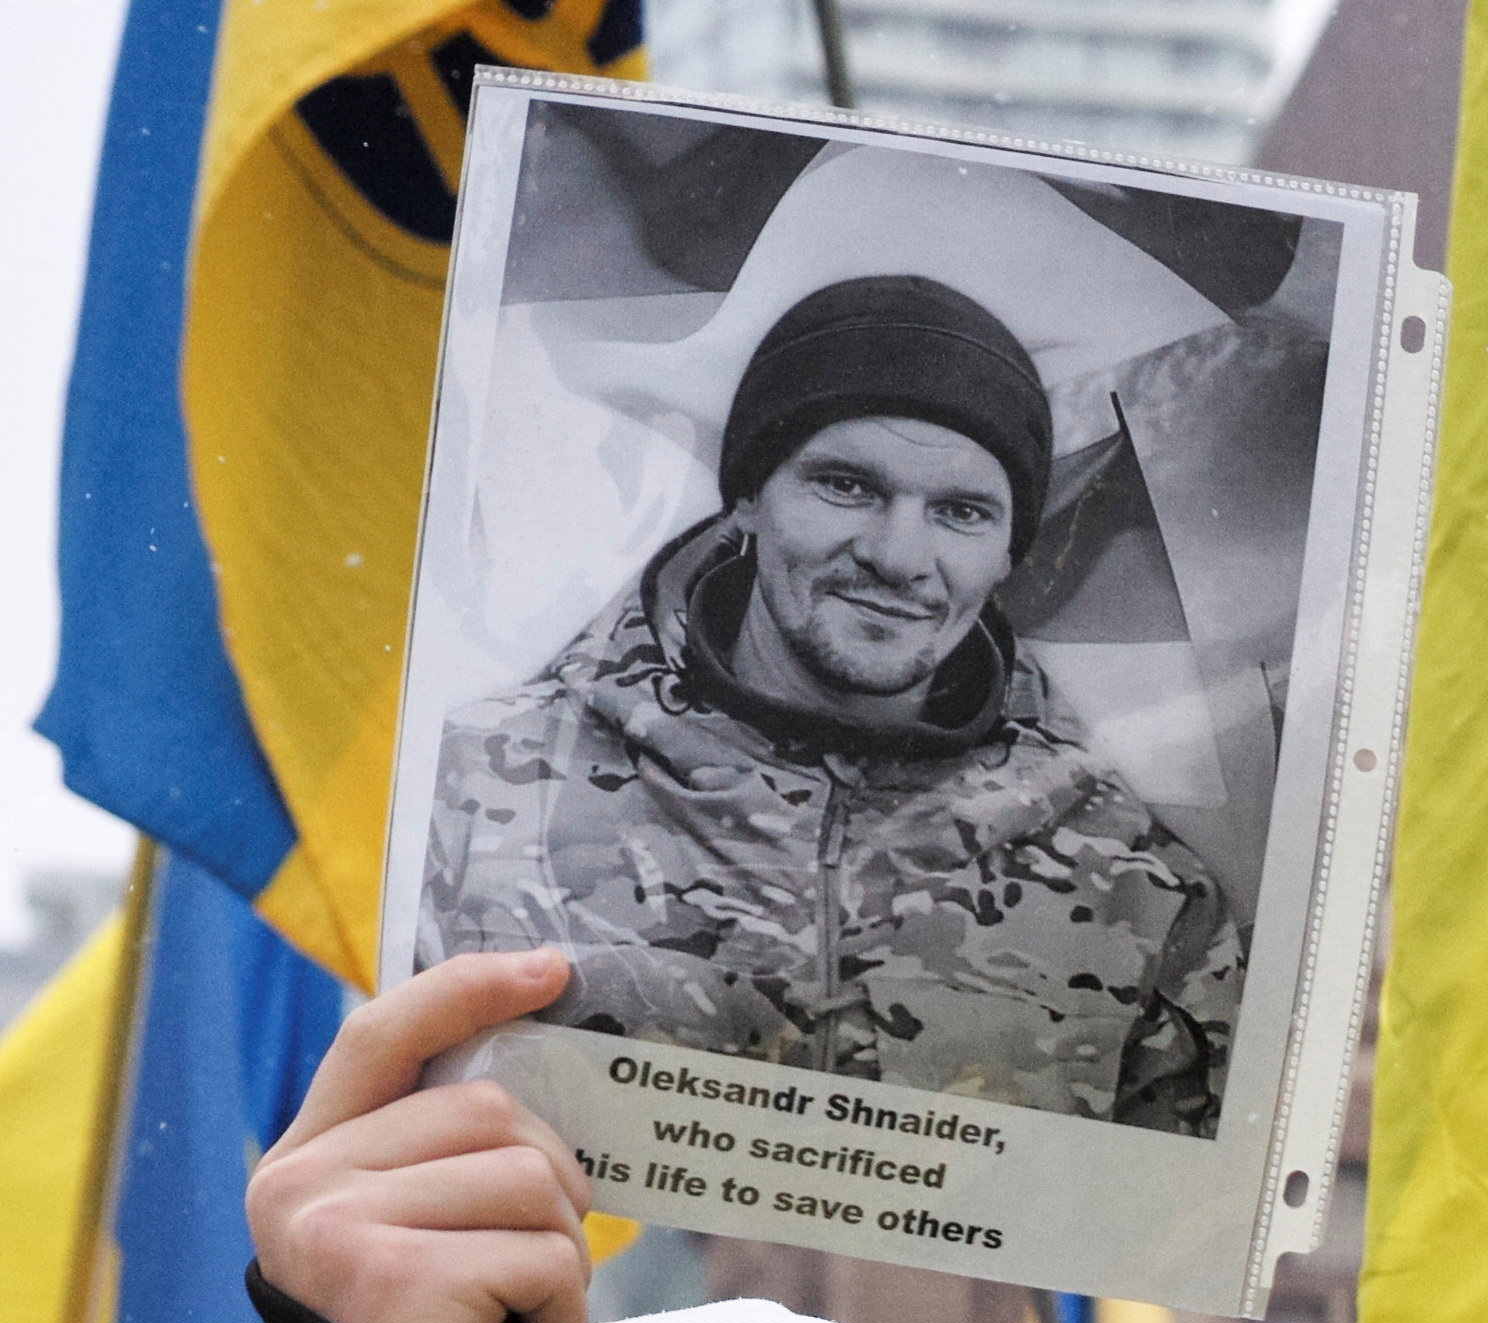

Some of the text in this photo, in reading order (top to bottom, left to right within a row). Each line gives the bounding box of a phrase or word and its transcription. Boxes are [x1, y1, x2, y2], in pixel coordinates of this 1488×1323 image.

[608, 1056, 1006, 1155] Oleksandr Shnaider,
[653, 1119, 948, 1190] who sacrificed
[644, 1161, 707, 1197] life
[721, 1176, 761, 1206] to
[772, 1191, 865, 1225] save
[877, 1208, 1004, 1250] others
